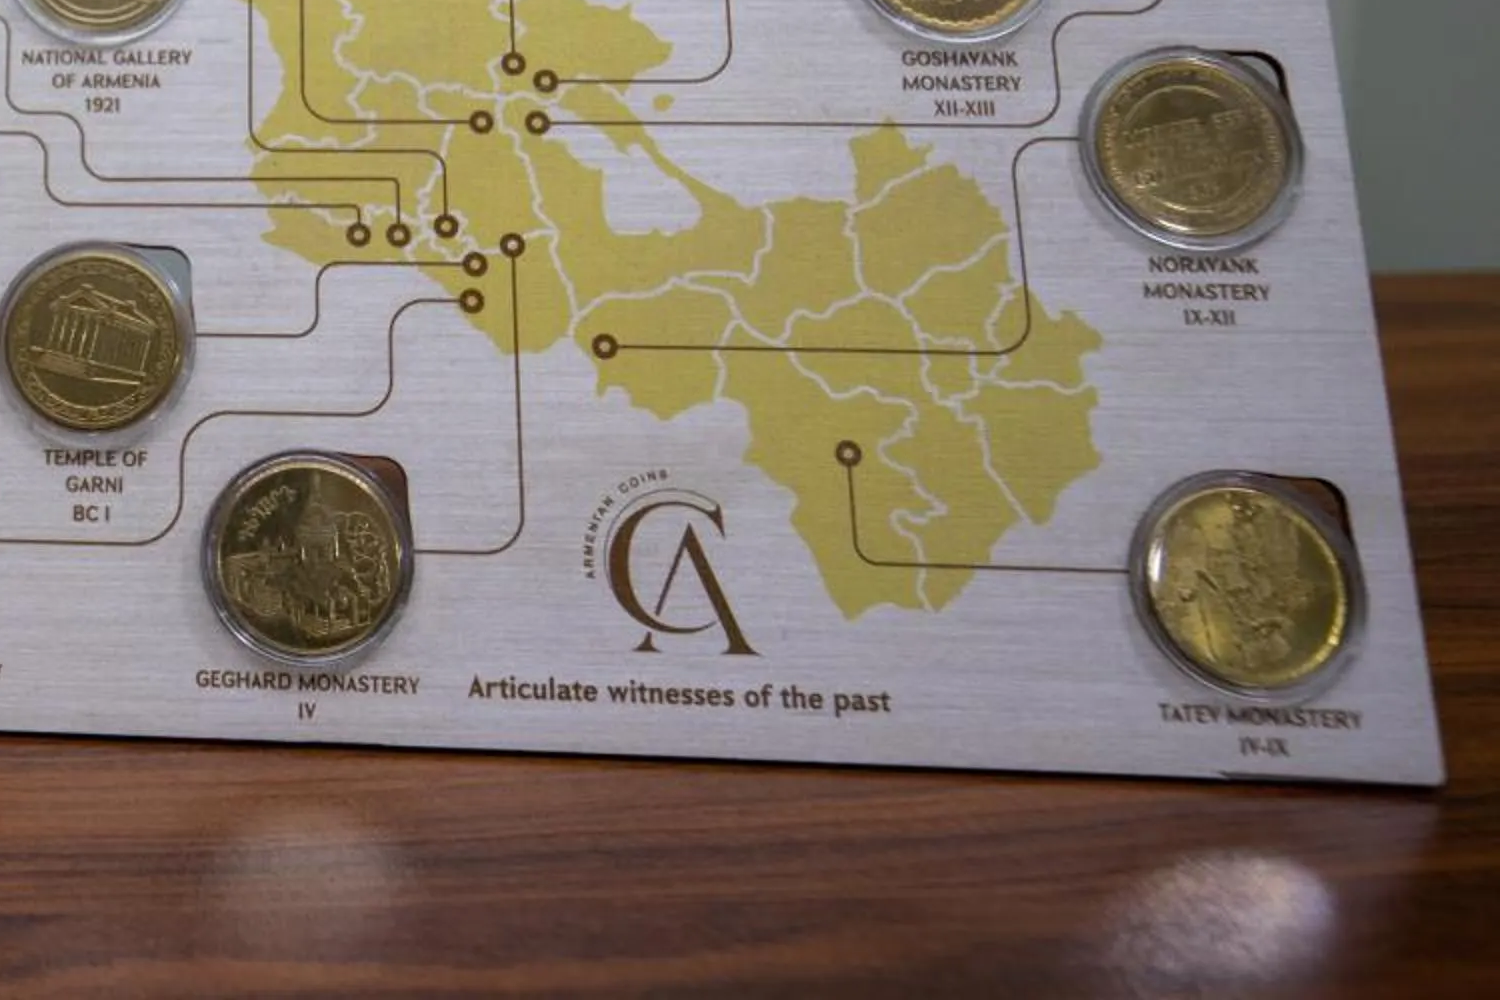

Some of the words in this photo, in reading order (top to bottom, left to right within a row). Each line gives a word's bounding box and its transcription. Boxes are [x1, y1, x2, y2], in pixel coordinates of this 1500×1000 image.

[22, 50, 107, 67] NATIONAL
[113, 49, 192, 67] GALLERY
[902, 50, 1018, 69] GOSHAVANK
[52, 73, 75, 90] OF
[81, 73, 161, 90] ARMENIA
[902, 74, 1020, 93] MONASTERY
[85, 97, 120, 113] 1921
[934, 99, 996, 117] XII-XIII
[1149, 257, 1259, 275] NORAVANK
[1143, 282, 1270, 303] MONASTERY
[43, 449, 117, 468] TEMPLE
[122, 450, 148, 467] OF
[65, 474, 124, 494] GARNI
[72, 504, 100, 522] BC
[583, 494, 616, 580] ARMENIAN
[617, 468, 669, 495] COINS
[196, 670, 292, 691] GEGHARD
[299, 672, 421, 695] MONASTERY
[468, 674, 599, 702] Articulate
[607, 680, 735, 707] witnesses
[743, 683, 773, 708] of
[781, 684, 823, 710] the
[834, 690, 893, 718] past
[299, 703, 315, 721] IV
[1158, 703, 1222, 723] TATEV
[1226, 707, 1362, 731] MONASTERY
